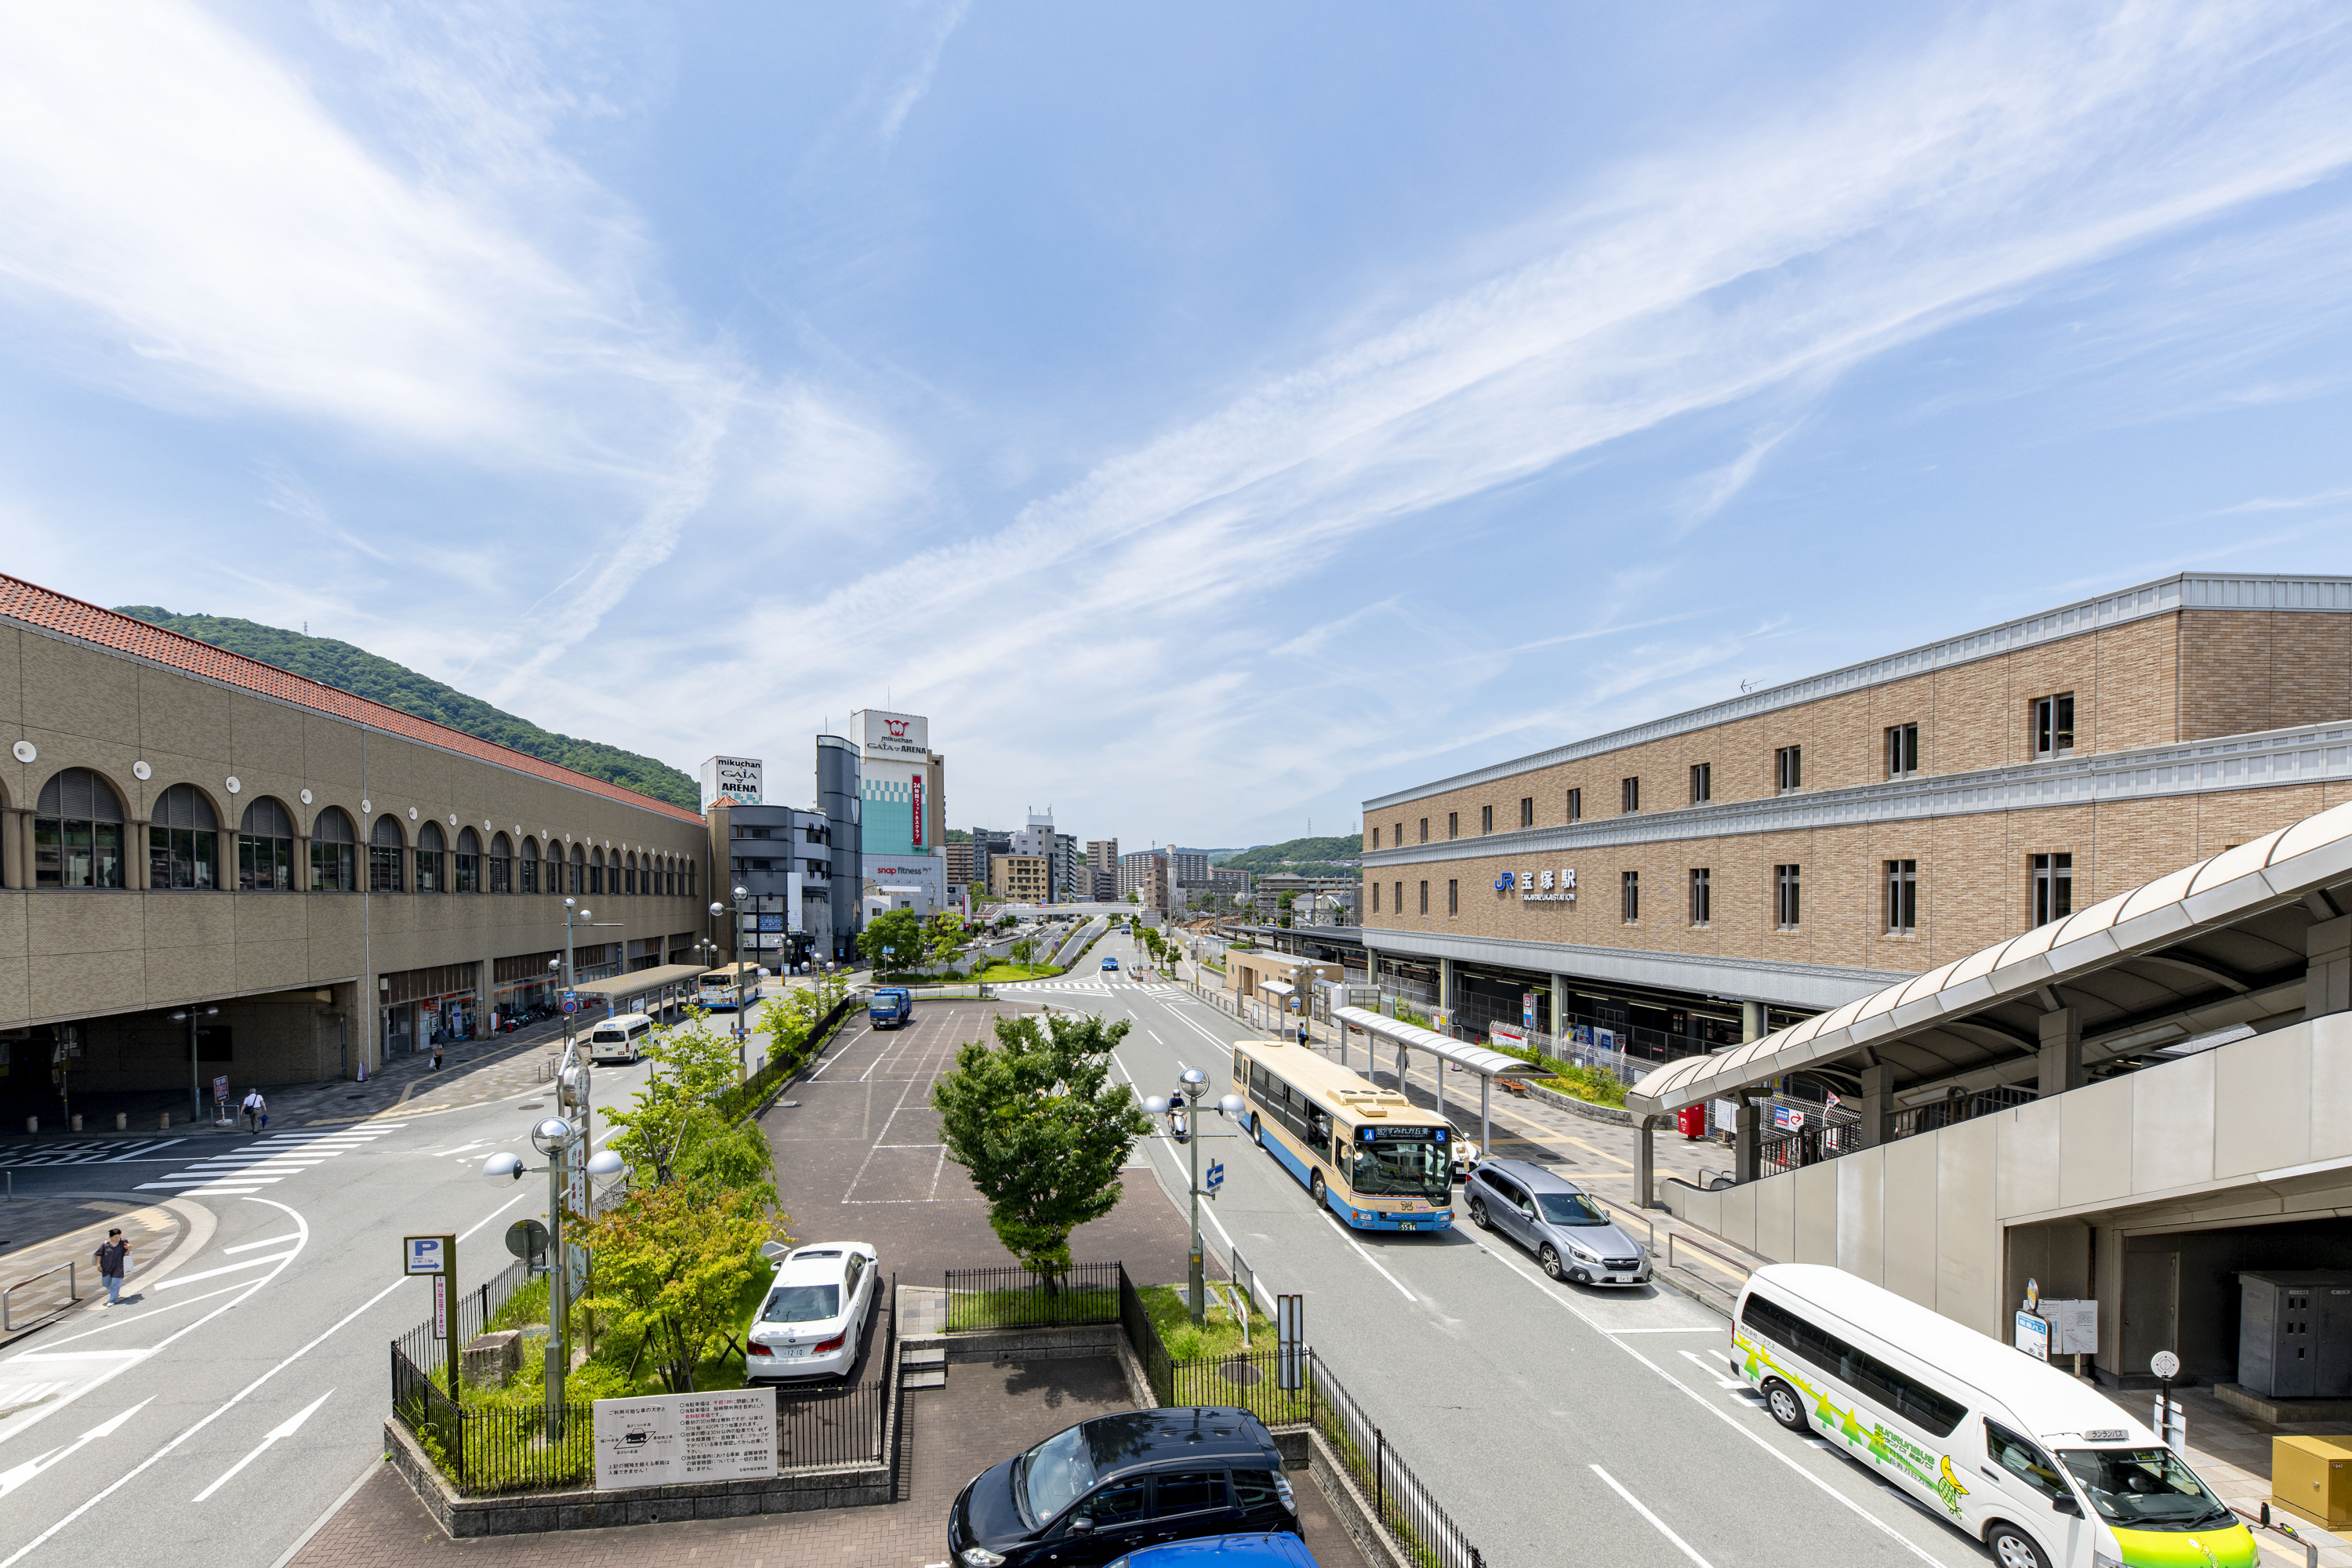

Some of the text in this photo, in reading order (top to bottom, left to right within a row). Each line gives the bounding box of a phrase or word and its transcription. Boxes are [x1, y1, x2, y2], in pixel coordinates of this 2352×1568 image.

[881, 735, 913, 744] mikuchan
[718, 759, 760, 769] mikuchan
[722, 782, 757, 793] ARENA
[913, 782, 921, 839] 24時間フィットネスクラブ
[877, 867, 897, 876] snap
[897, 866, 922, 875] fitness
[1494, 869, 1577, 891] JR 宝塚駅
[1377, 1127, 1387, 1136] 182
[415, 1240, 438, 1257] P
[1874, 1422, 1936, 1465] RUNRUNBUS
